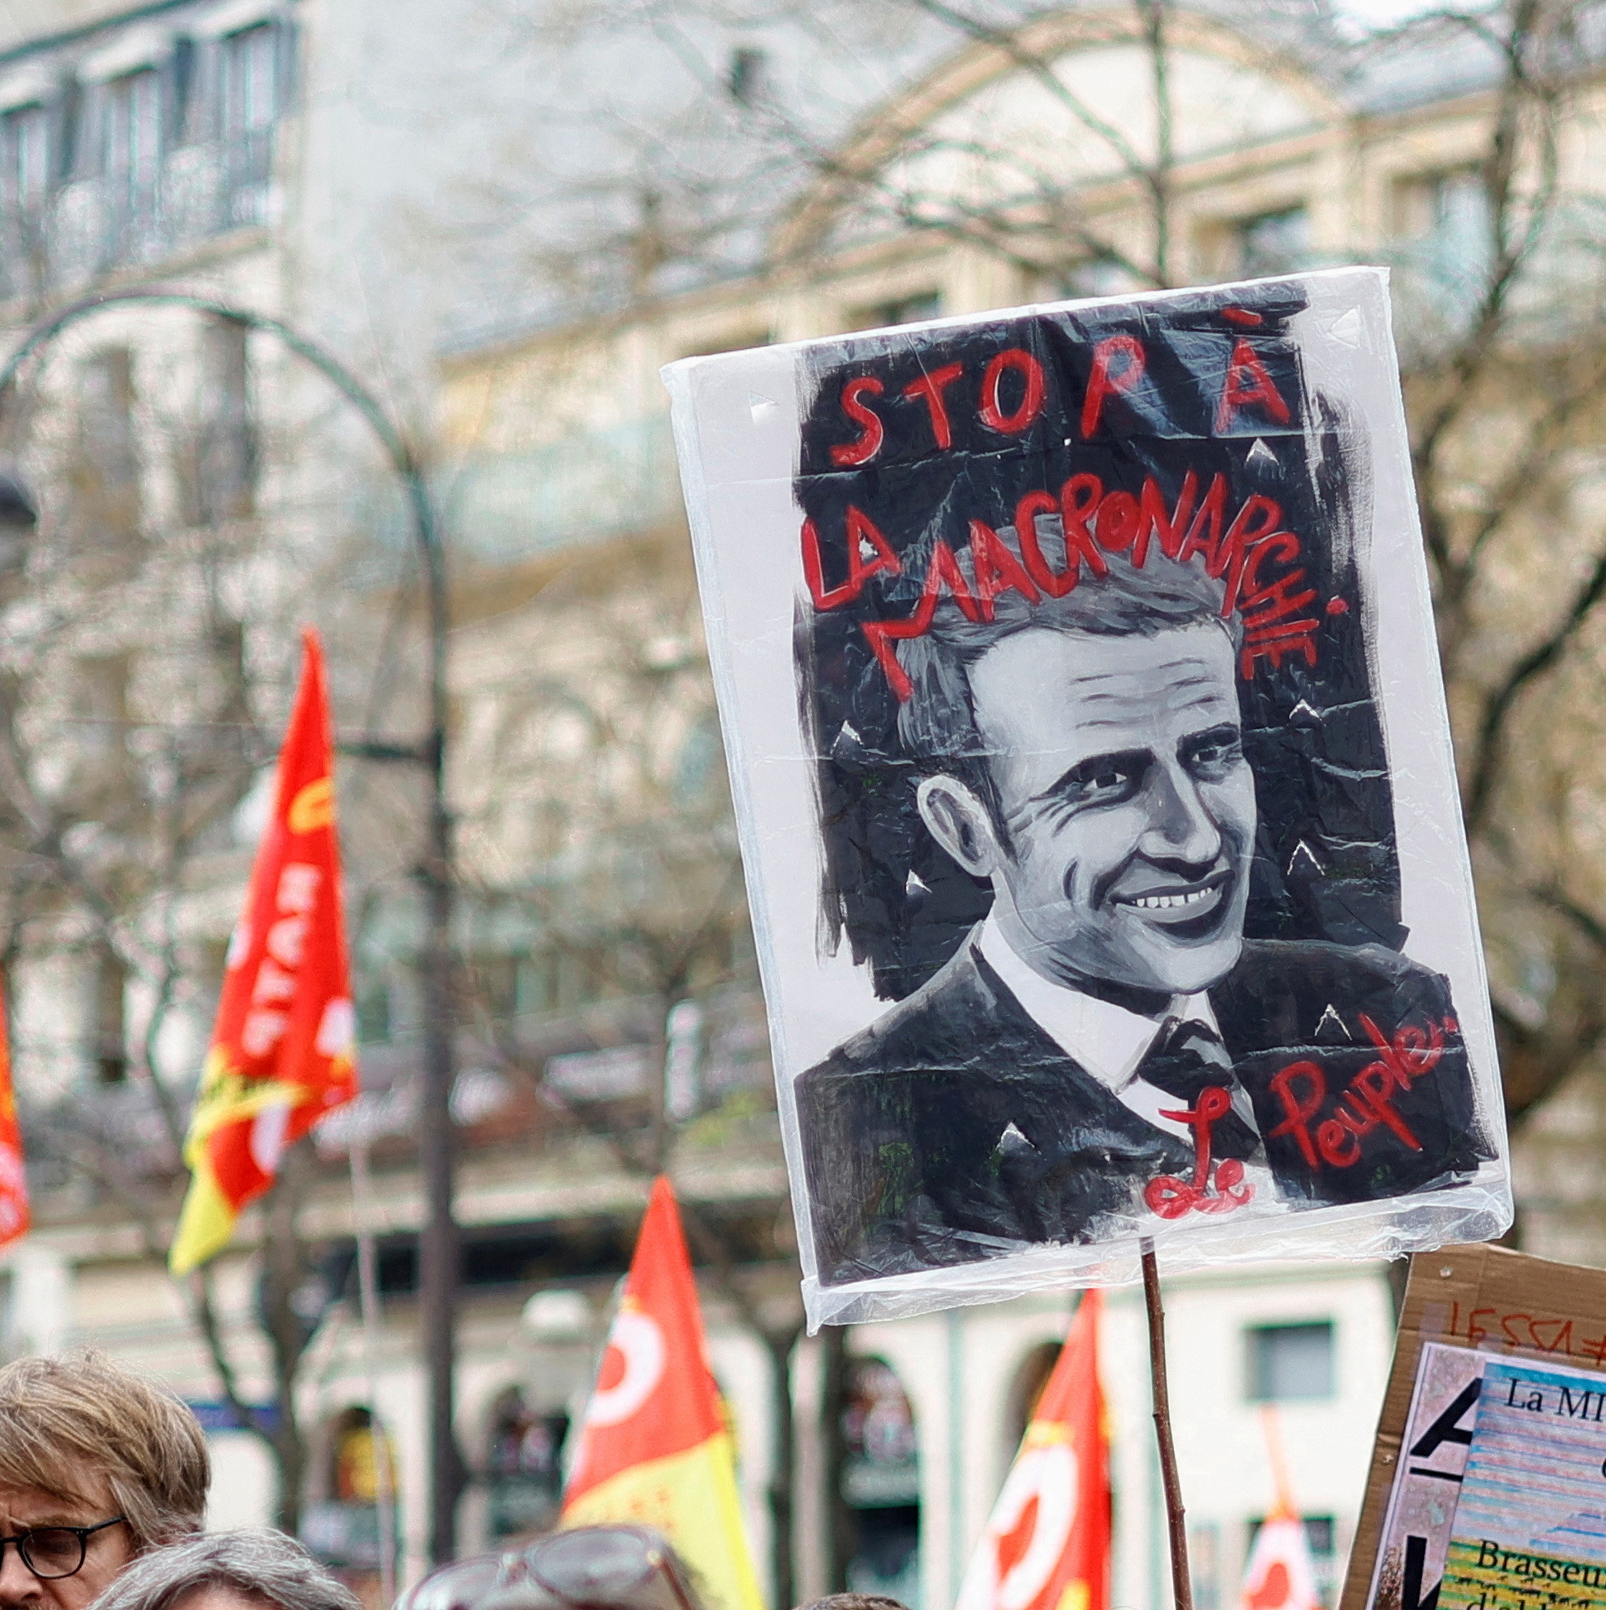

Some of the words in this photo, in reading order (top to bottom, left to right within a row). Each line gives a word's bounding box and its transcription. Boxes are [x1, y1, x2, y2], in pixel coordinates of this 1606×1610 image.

[830, 333, 1145, 466] STOP
[1213, 307, 1291, 434] À
[801, 504, 902, 612] LA
[1144, 1086, 1256, 1220] Le
[1504, 1378, 1543, 1413] La
